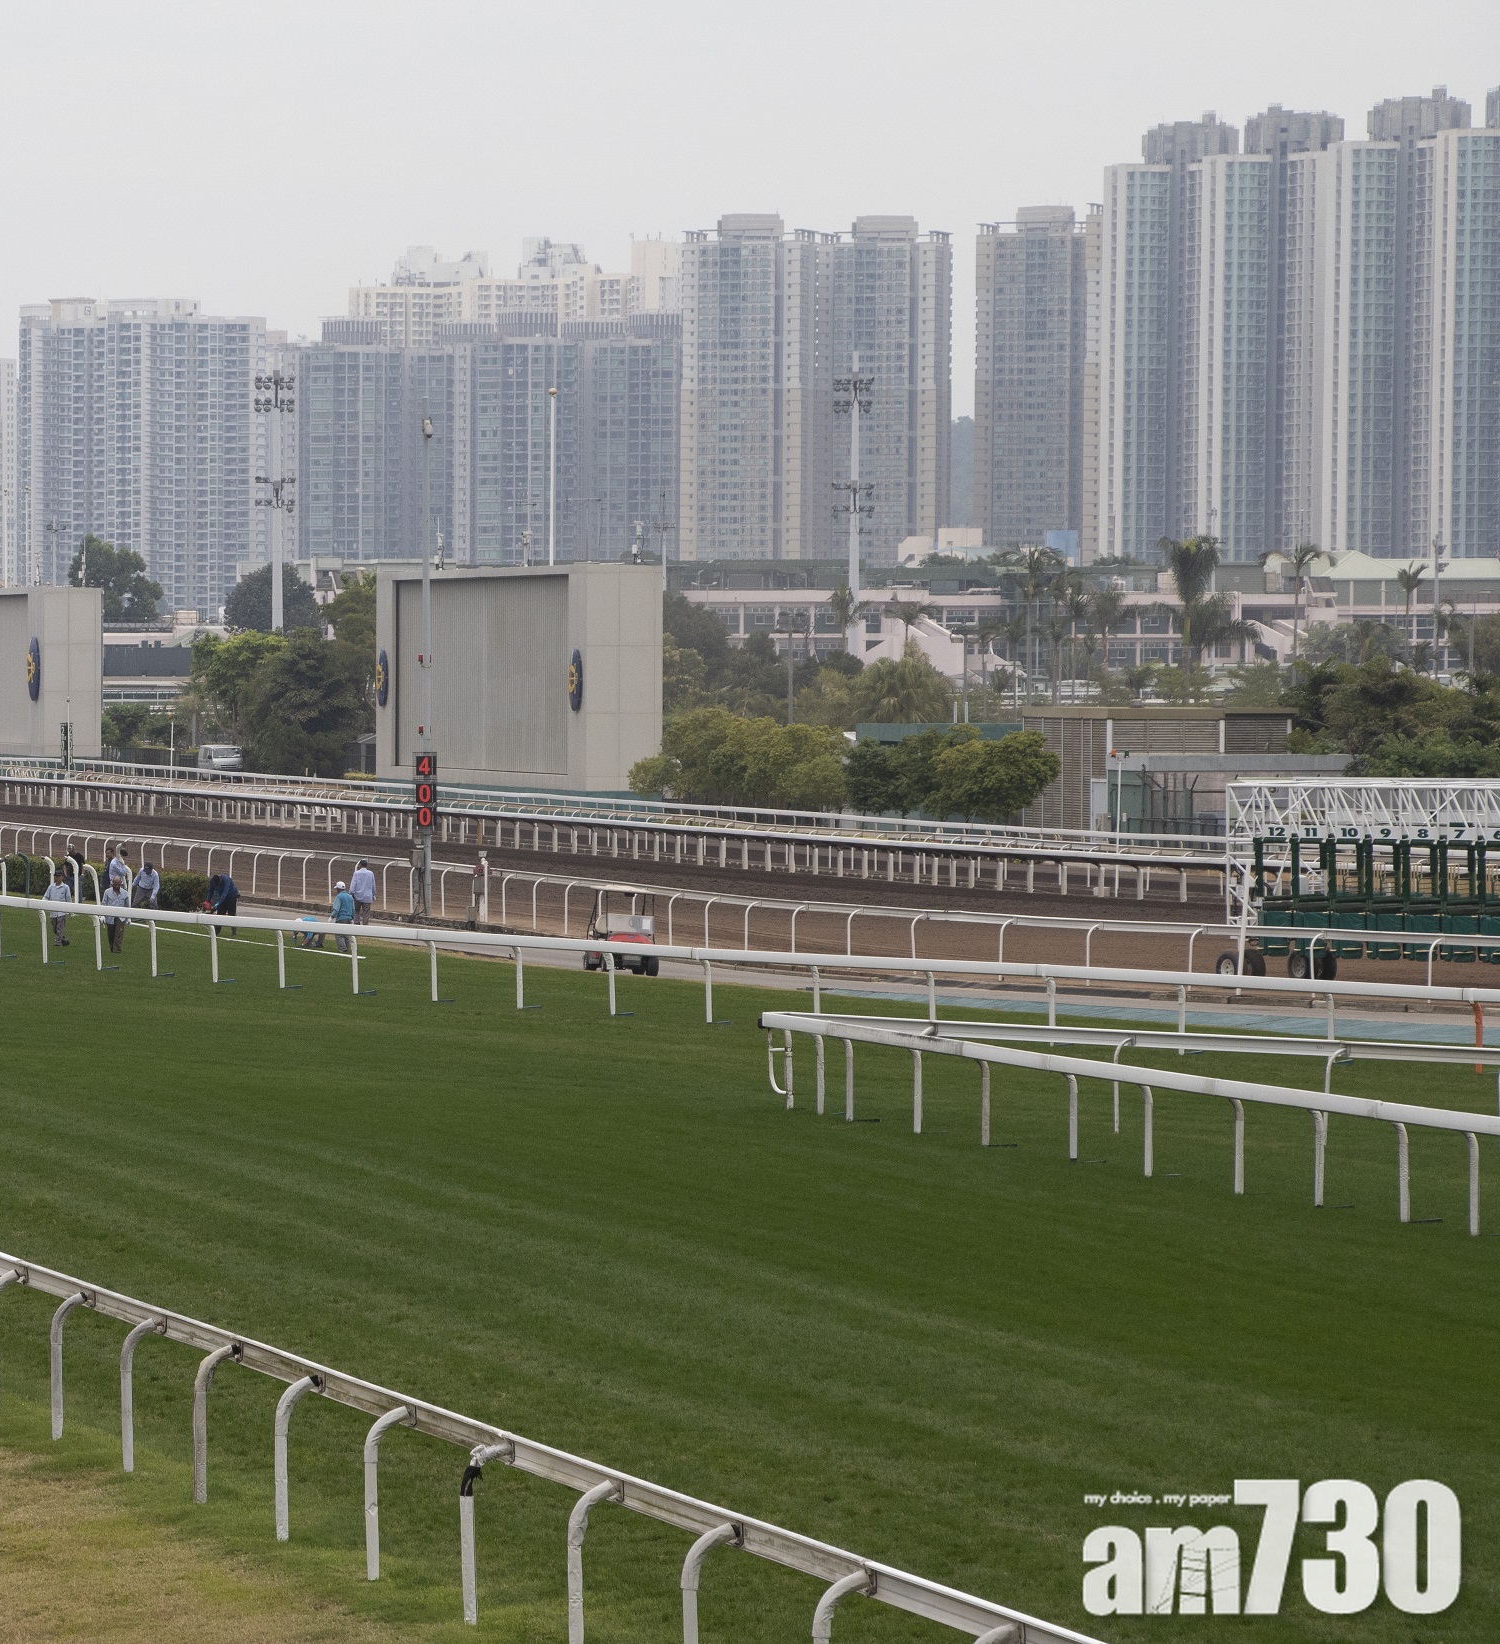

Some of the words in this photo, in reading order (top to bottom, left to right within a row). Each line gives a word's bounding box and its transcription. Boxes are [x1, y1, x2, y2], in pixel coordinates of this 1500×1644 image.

[418, 756, 432, 826] 400
[1268, 827, 1286, 837] 12
[1304, 827, 1318, 837] 11
[1341, 828, 1359, 837] 10
[1380, 828, 1391, 838] 9
[1417, 829, 1429, 838] 8
[1454, 829, 1466, 839] 7
[1493, 830, 1500, 839] 6
